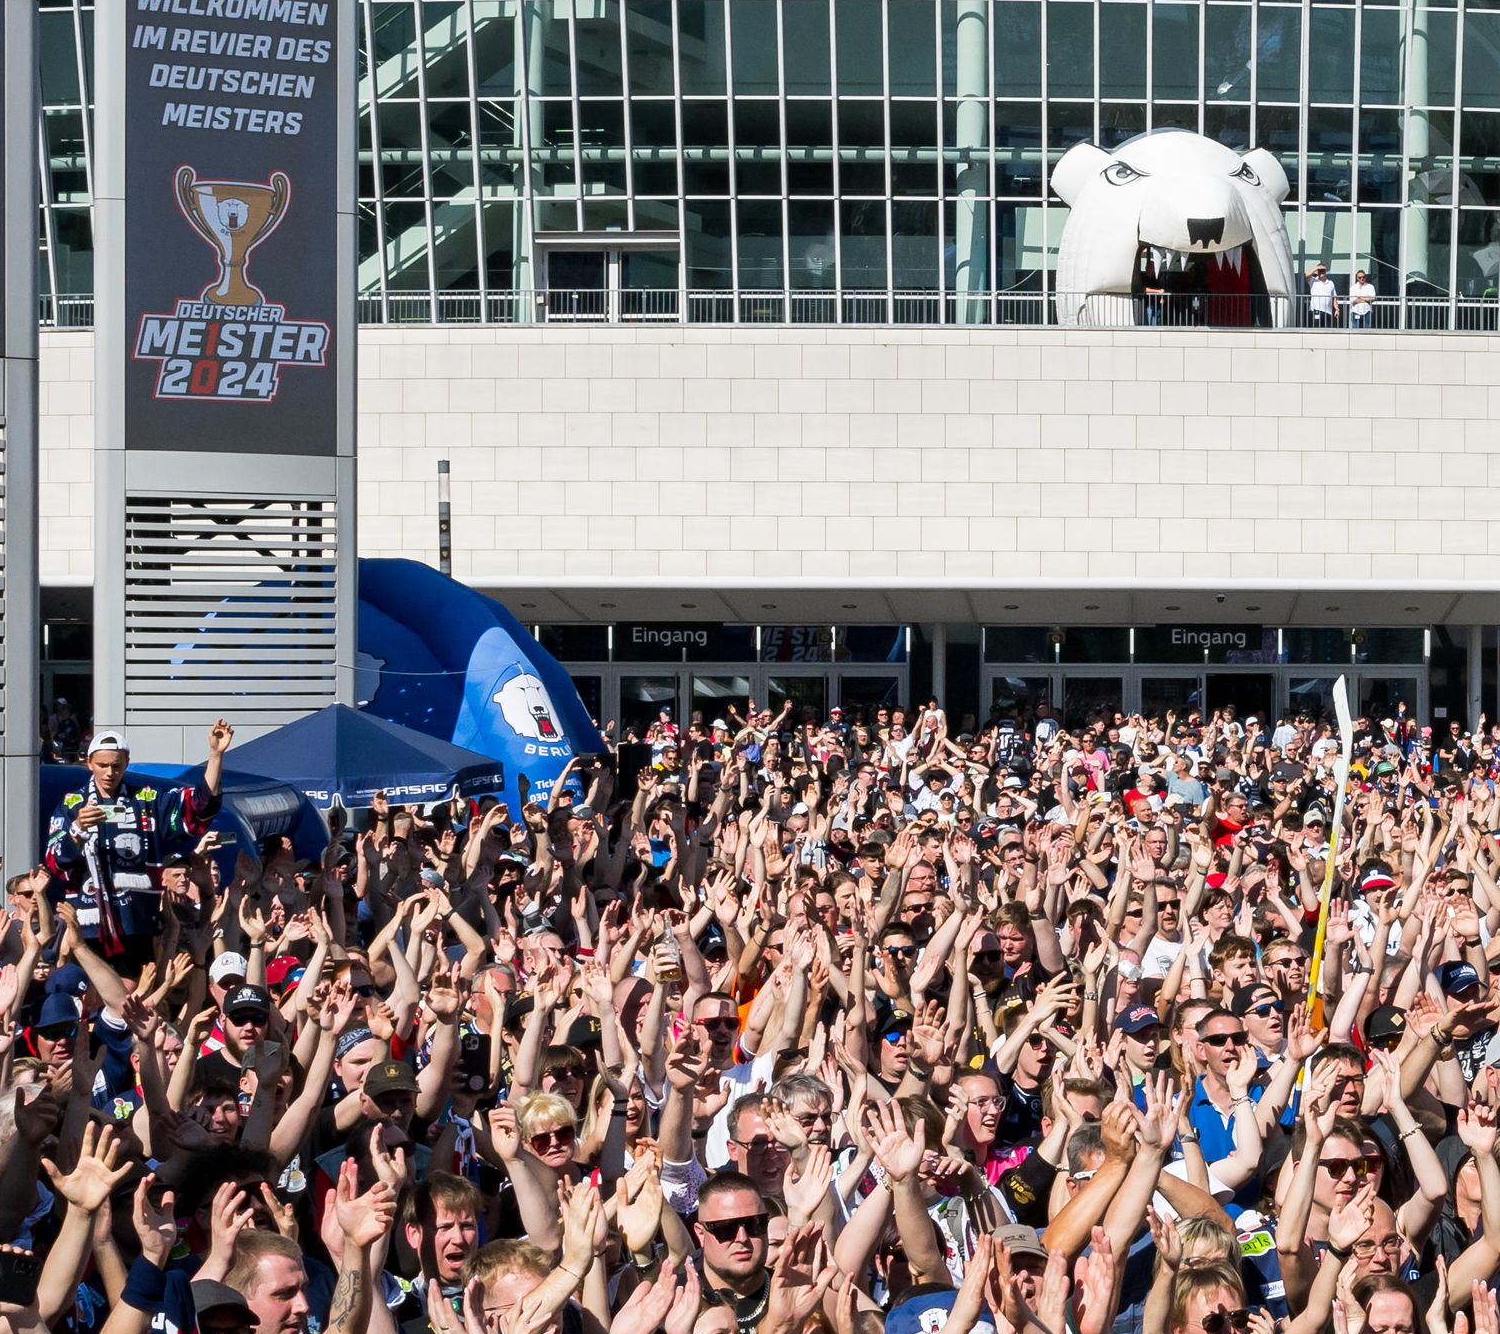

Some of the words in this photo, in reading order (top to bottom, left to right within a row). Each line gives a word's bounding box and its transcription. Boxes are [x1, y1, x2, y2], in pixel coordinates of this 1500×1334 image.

[132, 24, 162, 50] IM
[171, 28, 273, 61] REVIER
[275, 36, 333, 64] DES
[149, 63, 316, 100] DEUTSCHEN
[161, 102, 304, 136] MEISTERS
[179, 304, 281, 324] DEUTSCHER
[161, 359, 276, 397] 2024
[632, 626, 708, 647] Eingang
[1171, 628, 1247, 649] Eingang
[384, 783, 448, 797] GASAG
[529, 792, 548, 803] 030
